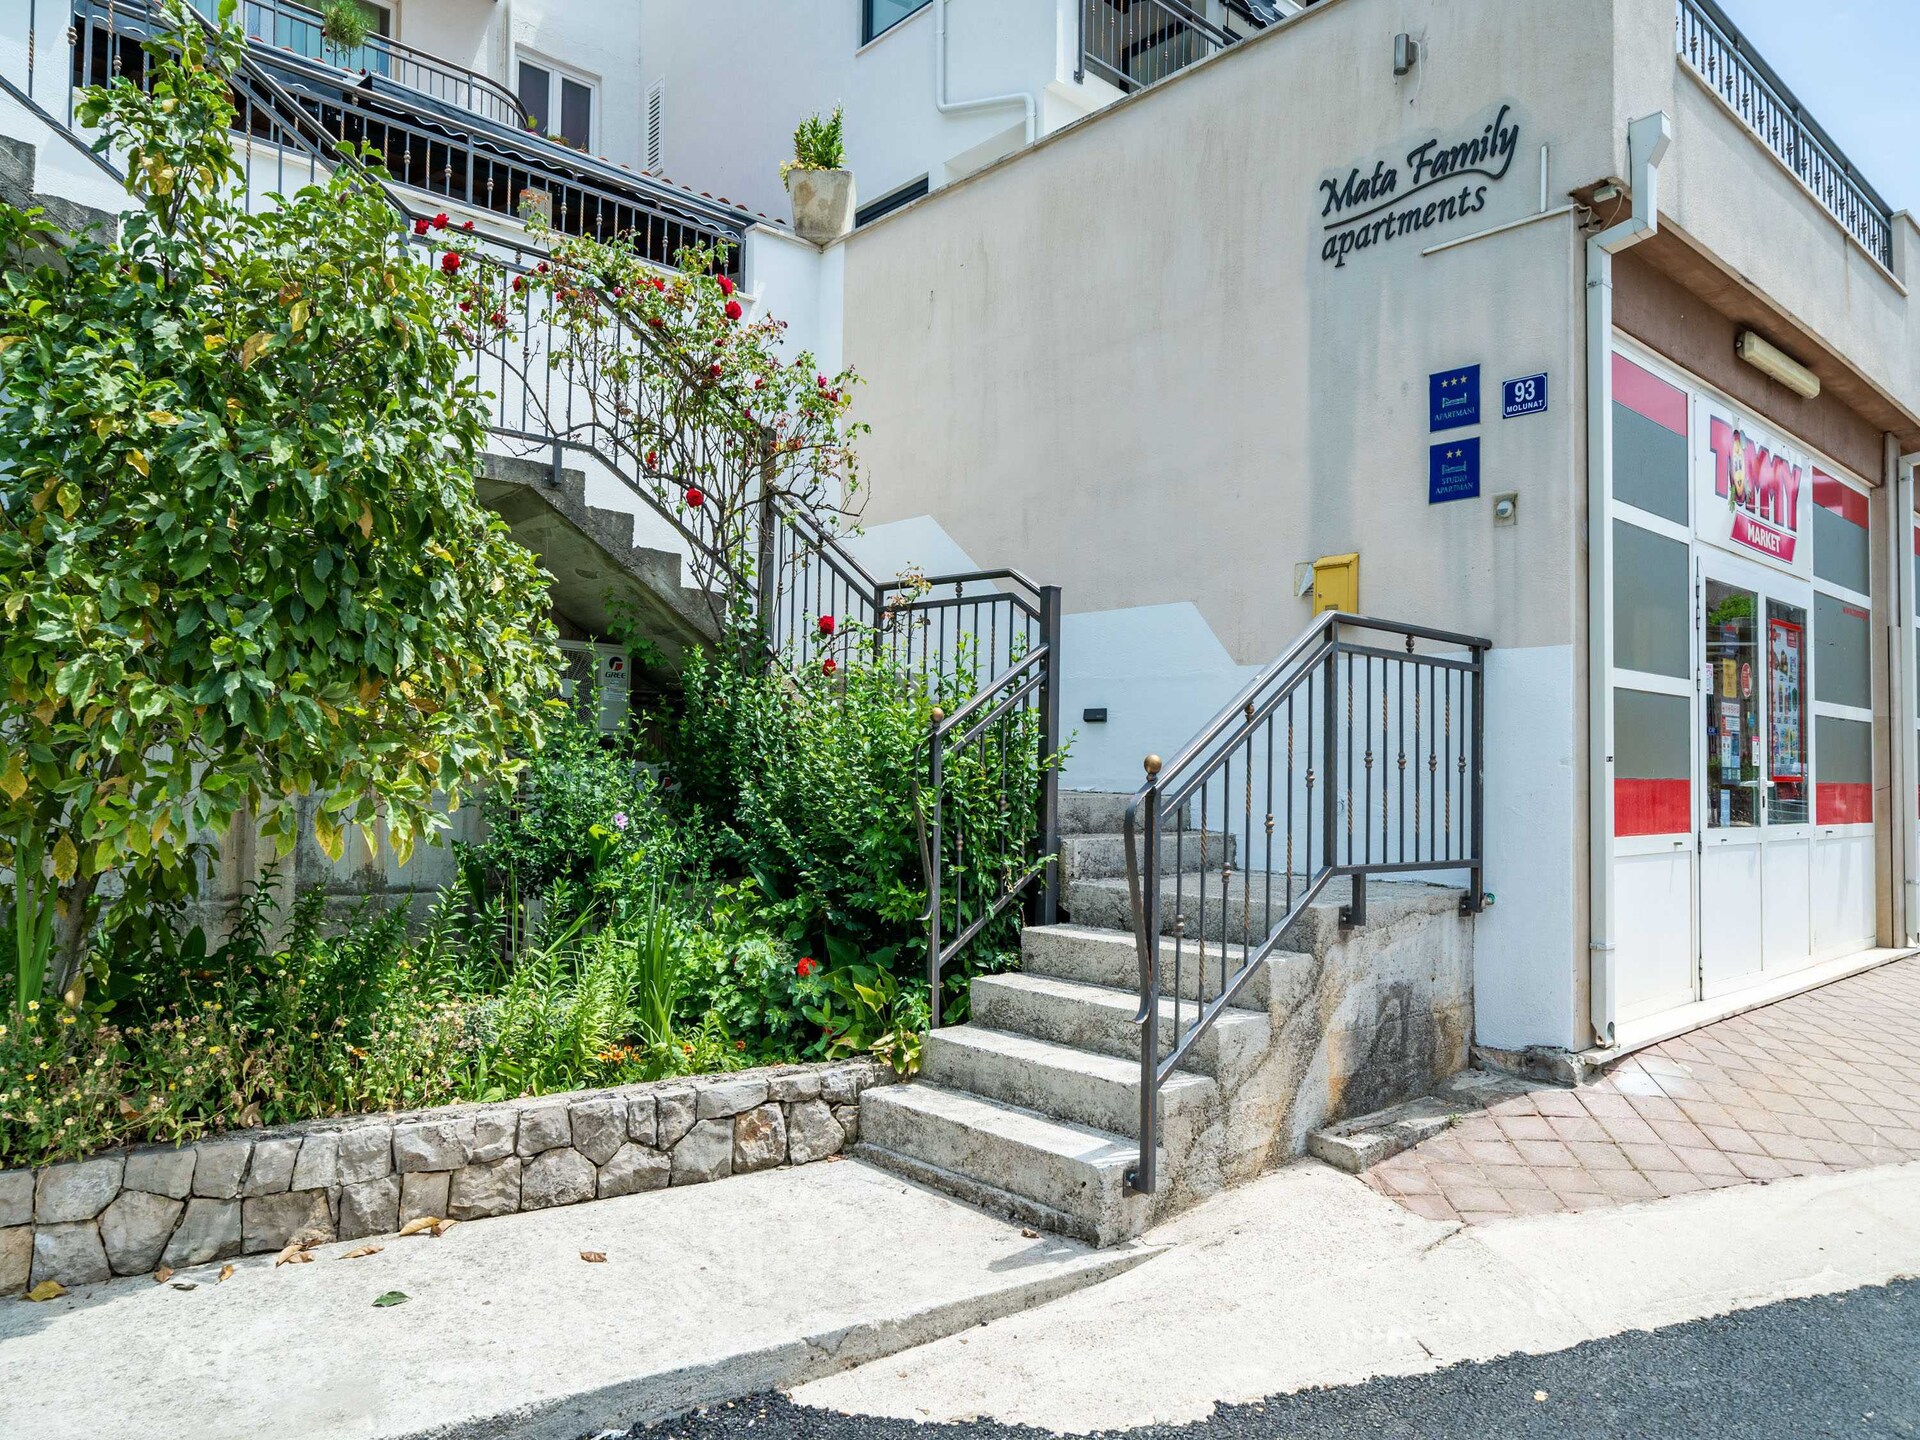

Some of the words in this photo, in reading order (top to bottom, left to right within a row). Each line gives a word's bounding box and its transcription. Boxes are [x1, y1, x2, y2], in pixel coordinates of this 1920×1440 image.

[1319, 160, 1397, 216] Mata
[1406, 104, 1519, 184] Family
[1321, 185, 1487, 268] apartments
[1514, 379, 1536, 403] 93
[1434, 406, 1475, 421] APARTMANI
[1506, 399, 1544, 413] MOLUNAT
[1441, 474, 1467, 485] STUDIO
[1434, 482, 1474, 496] APARTMAN
[1747, 523, 1781, 553] MARKET
[605, 671, 626, 679] GREE
